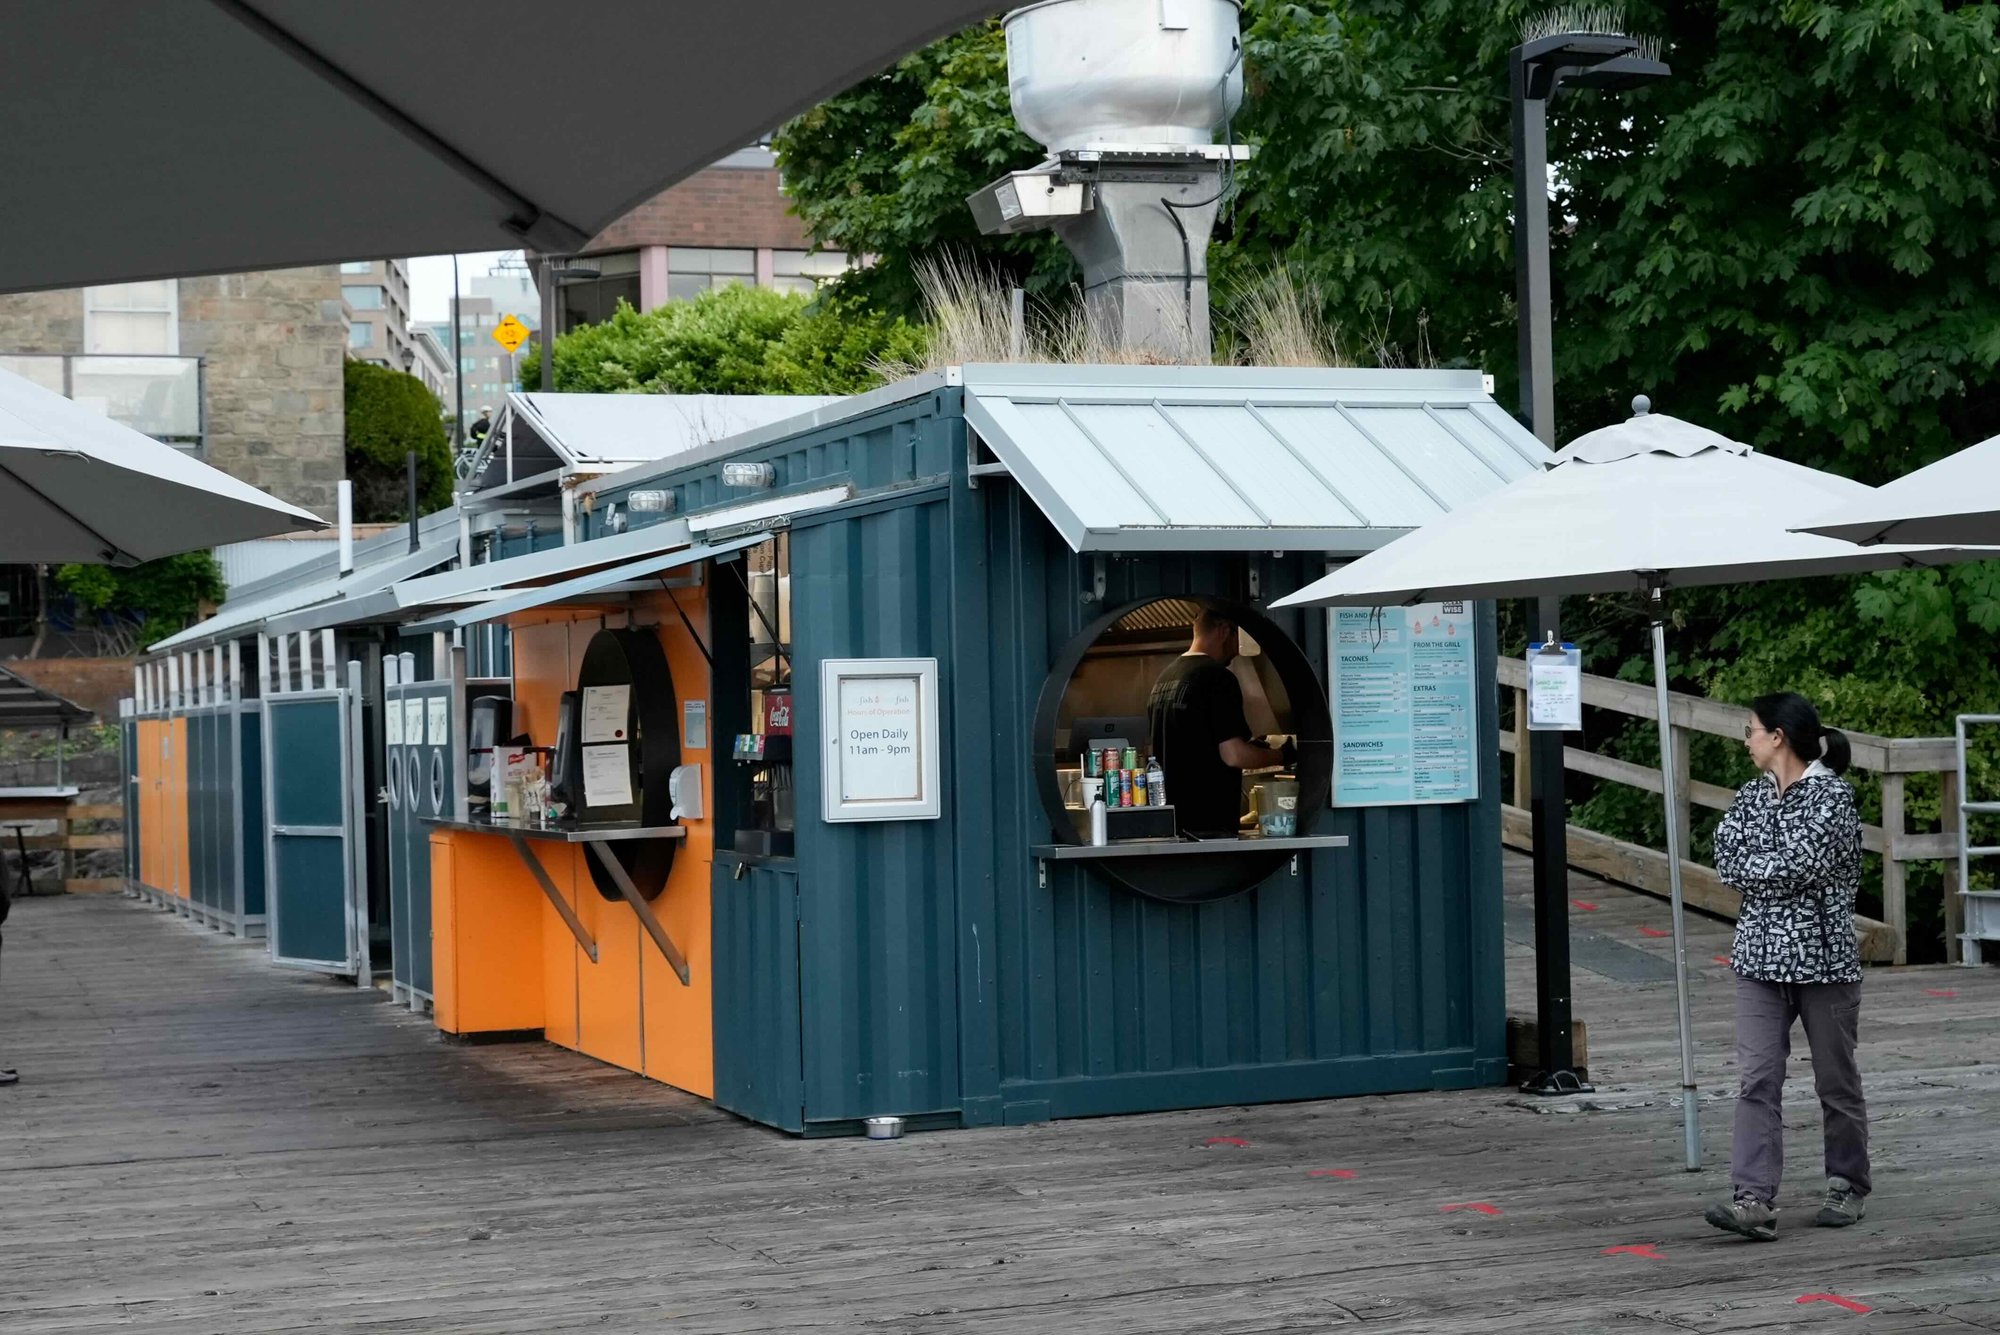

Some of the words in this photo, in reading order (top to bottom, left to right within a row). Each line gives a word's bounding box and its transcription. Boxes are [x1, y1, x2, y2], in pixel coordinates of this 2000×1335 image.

[850, 729, 880, 742] Open
[882, 728, 908, 741] Daily
[850, 745, 878, 755] 11am
[886, 744, 911, 756] 9pm
